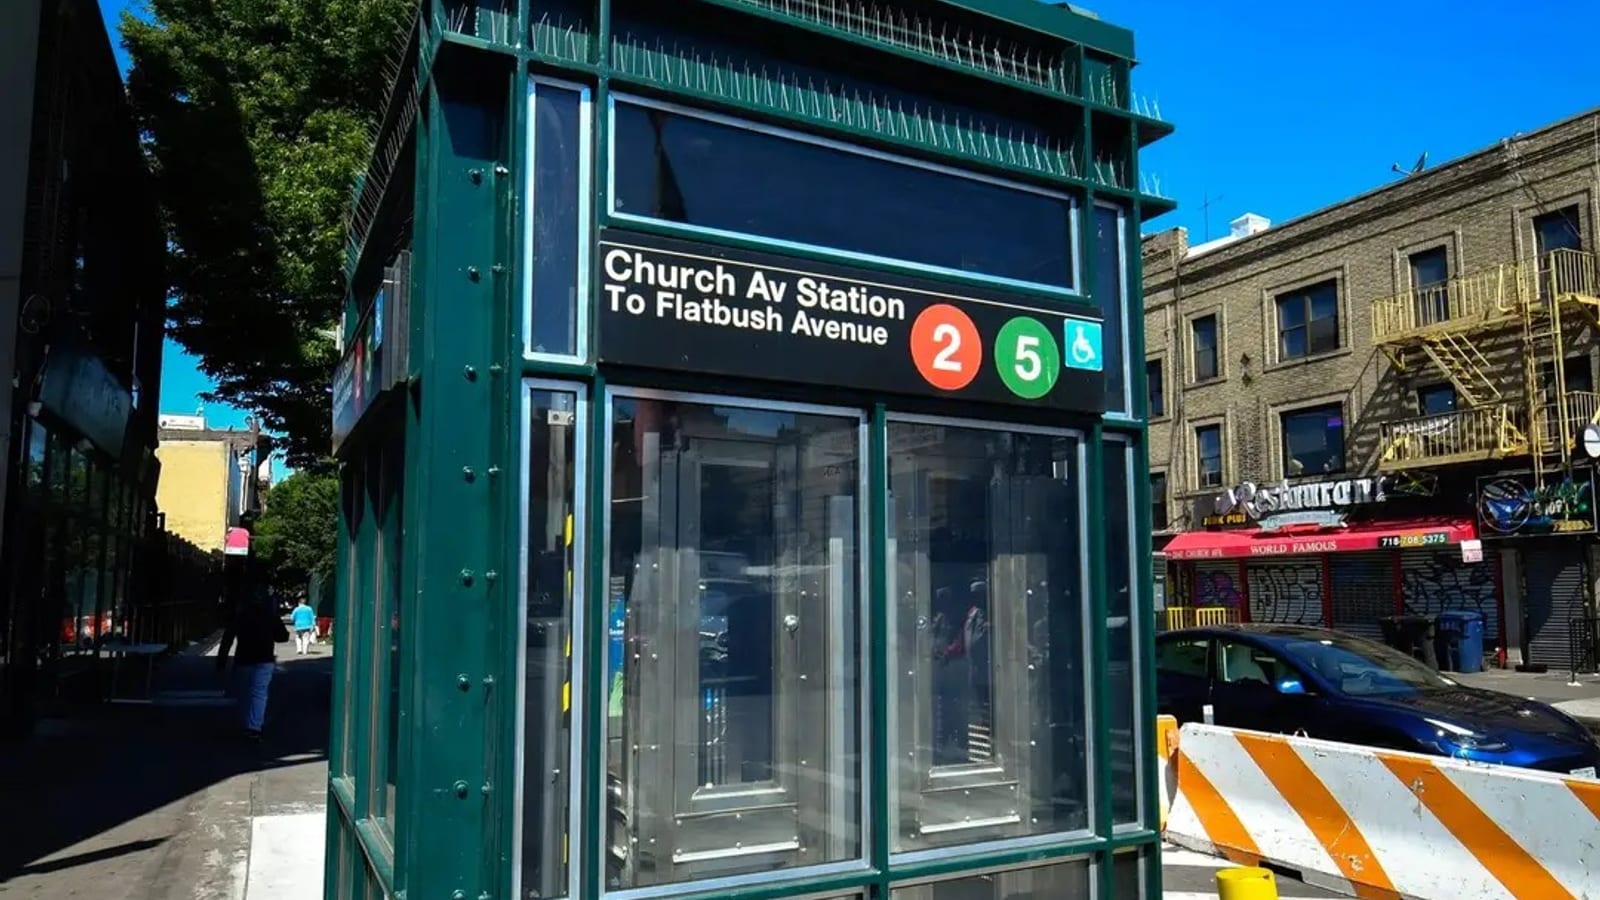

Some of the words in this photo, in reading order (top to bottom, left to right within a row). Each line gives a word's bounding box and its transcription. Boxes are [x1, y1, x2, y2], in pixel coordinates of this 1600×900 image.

[604, 249, 736, 296] Church
[746, 271, 787, 303] Av
[796, 277, 905, 320] Station
[604, 283, 646, 315] To
[656, 291, 783, 332] Flatbush
[791, 310, 889, 345] Avenue
[932, 323, 963, 372] 2
[1014, 334, 1042, 381] 5
[1250, 543, 1287, 555] WORLD
[1293, 540, 1337, 553] FAMOUS
